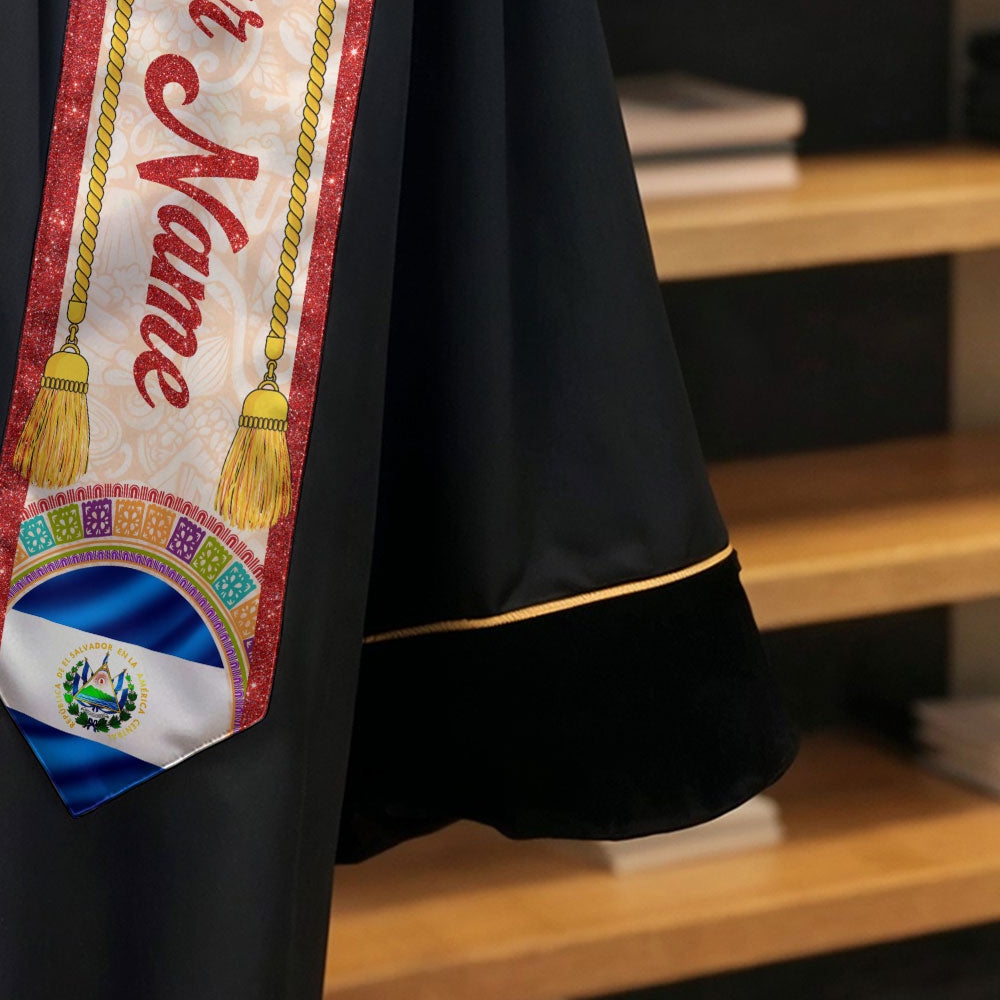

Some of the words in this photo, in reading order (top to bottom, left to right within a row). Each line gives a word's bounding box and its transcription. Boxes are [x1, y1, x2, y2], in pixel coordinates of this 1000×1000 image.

[135, 53, 260, 408] Name
[70, 642, 113, 658] SALVADOR
[117, 648, 129, 659] EN
[128, 657, 138, 668] LA
